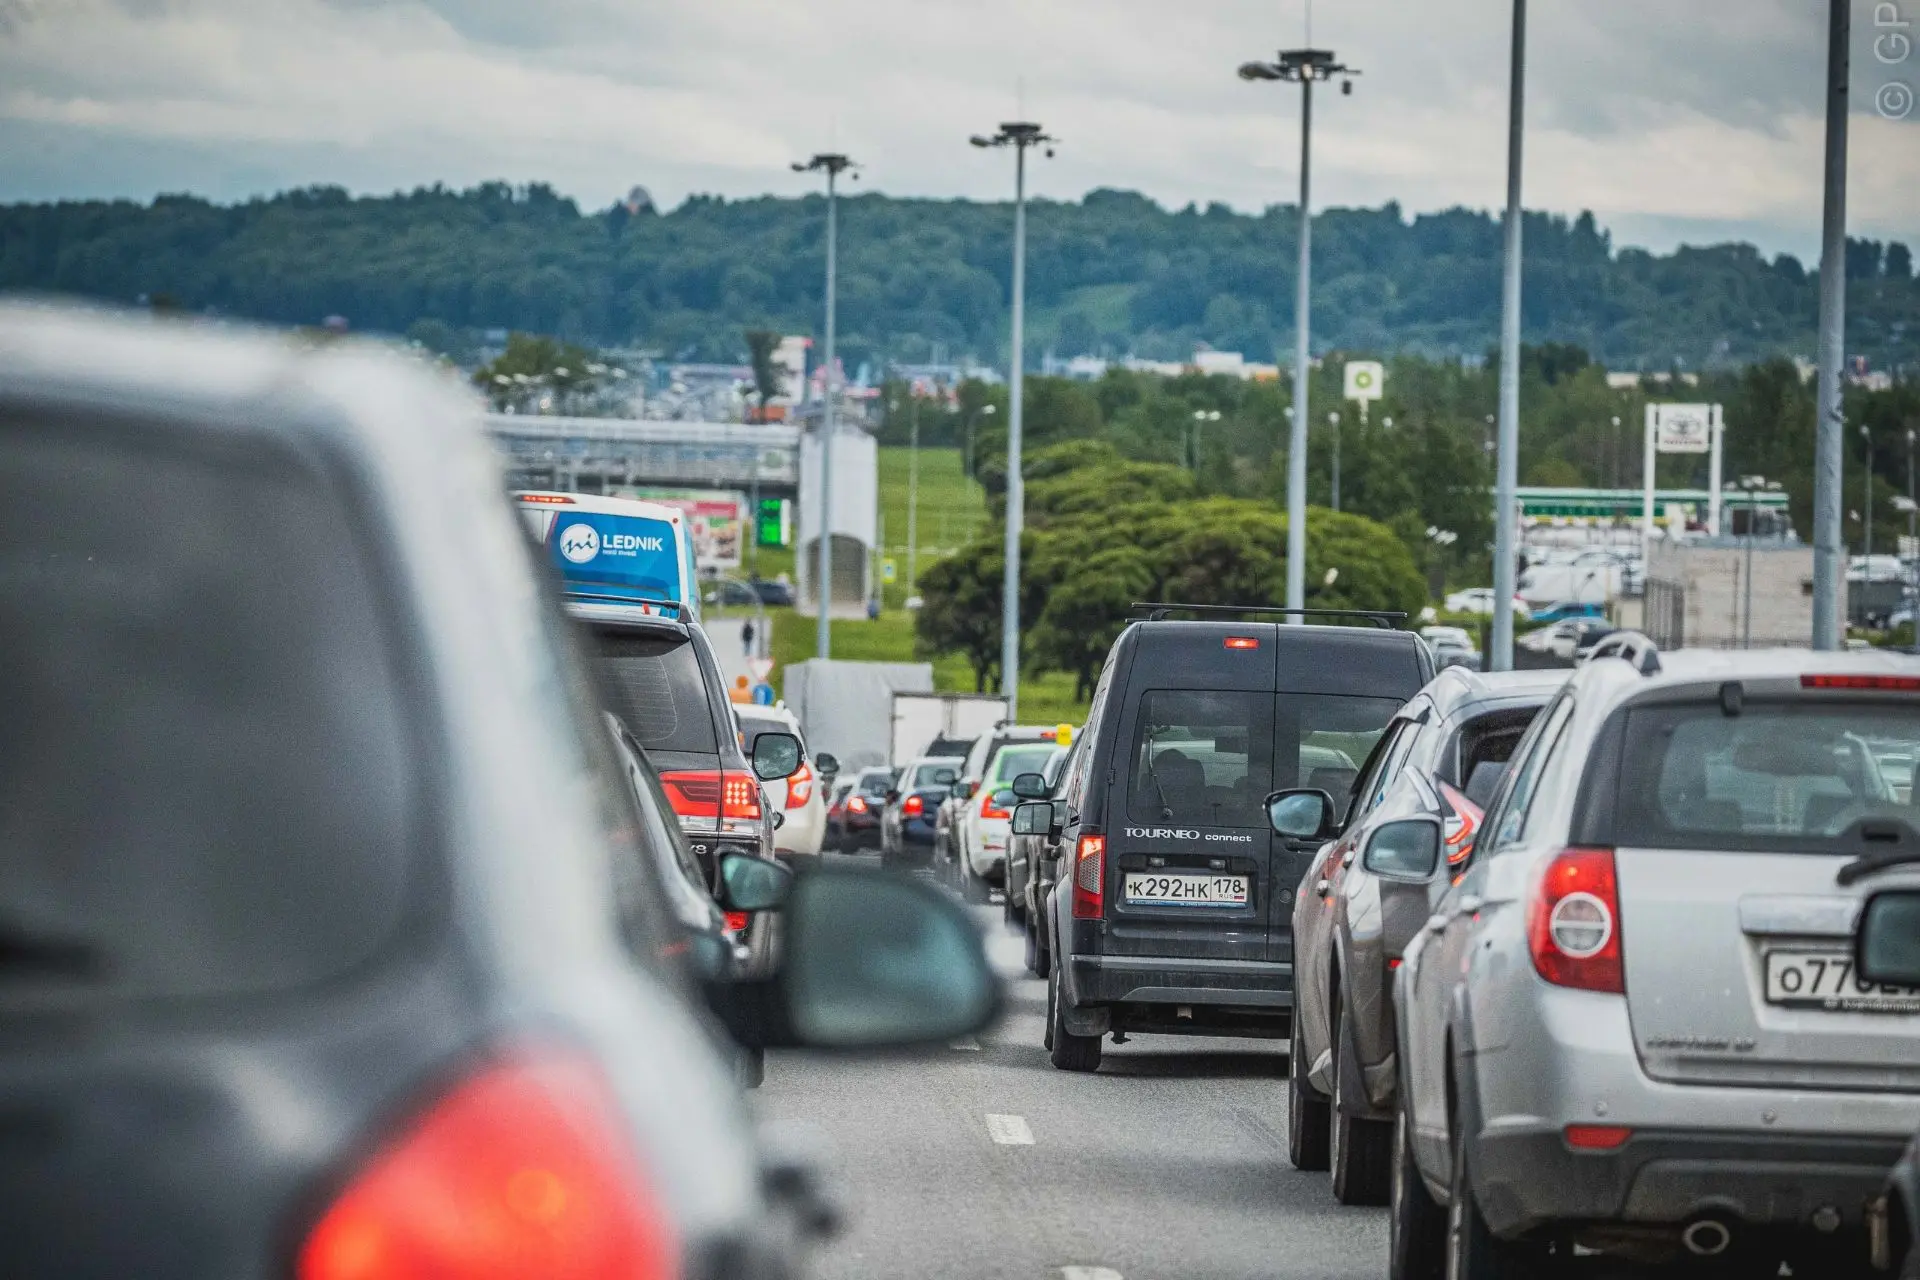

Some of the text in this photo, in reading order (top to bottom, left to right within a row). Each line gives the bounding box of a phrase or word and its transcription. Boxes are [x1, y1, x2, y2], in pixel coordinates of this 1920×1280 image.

[602, 534, 664, 552] LEDNIK
[1124, 827, 1252, 842] TOURNEO connect
[1133, 877, 1241, 899] К292НК 178
